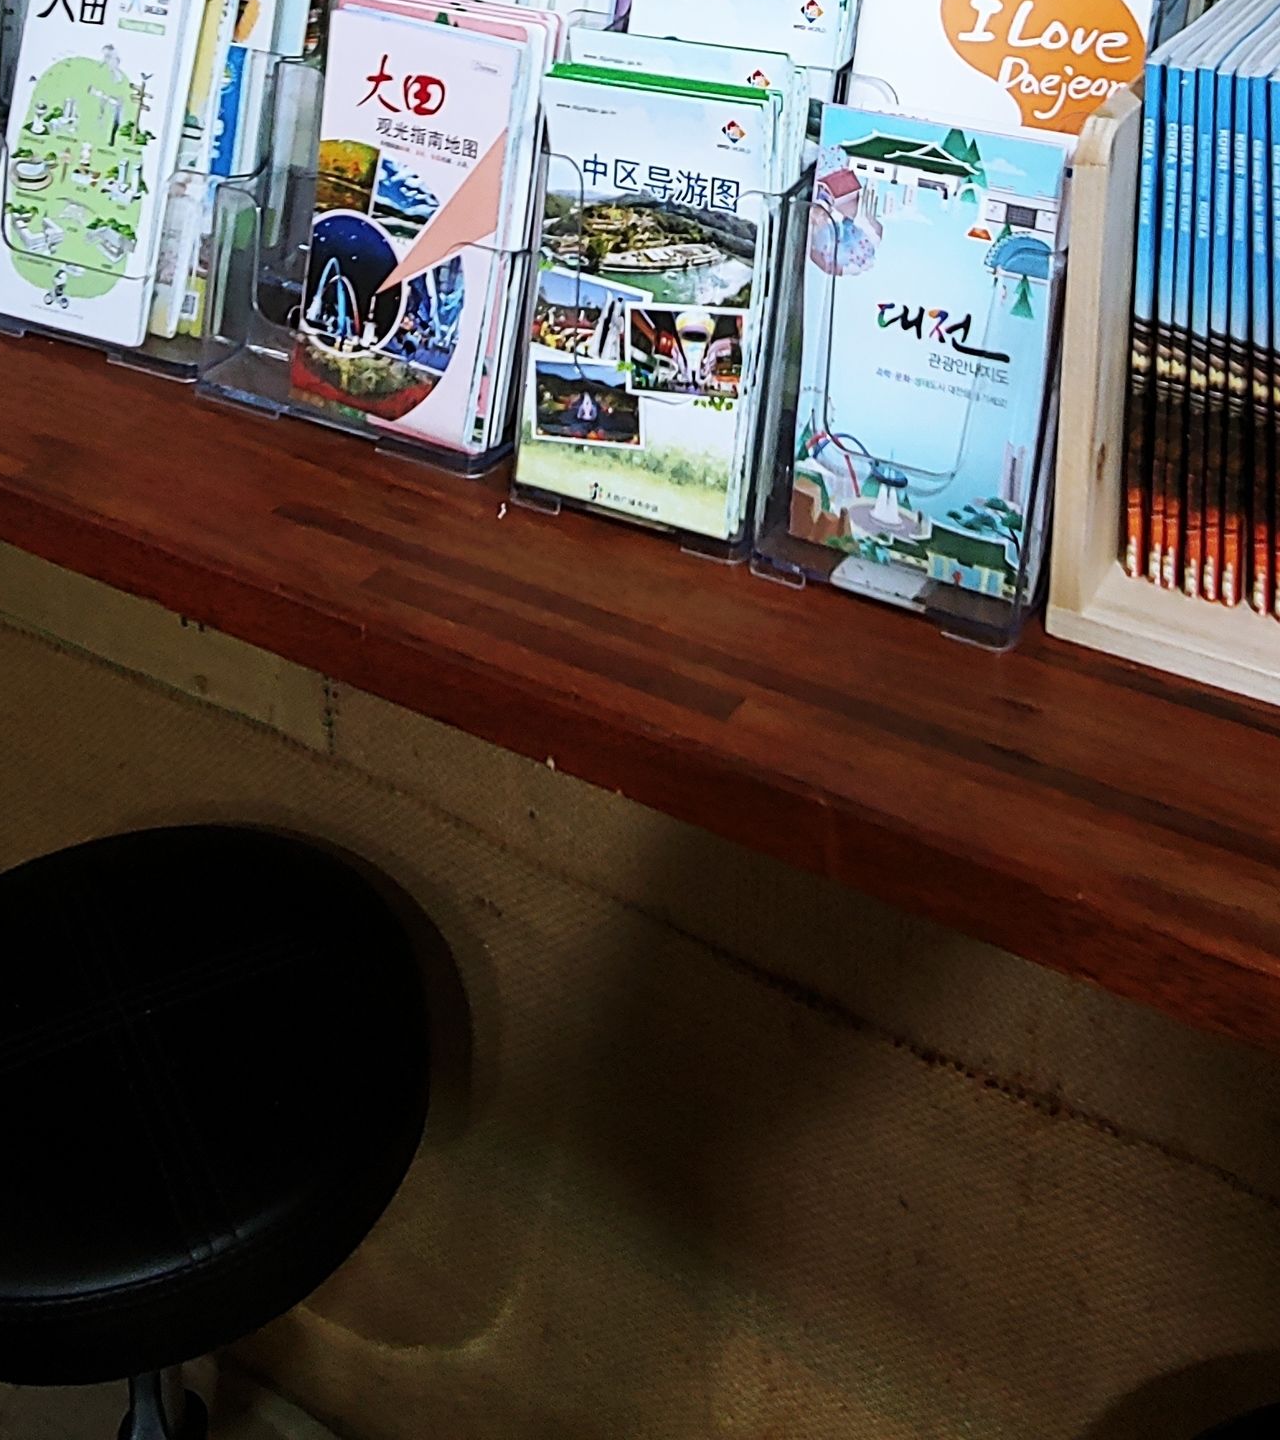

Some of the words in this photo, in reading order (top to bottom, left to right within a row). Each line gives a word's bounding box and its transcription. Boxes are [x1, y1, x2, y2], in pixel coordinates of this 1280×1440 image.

[1007, 0, 1133, 63] Love
[357, 54, 446, 116] 大田
[582, 153, 741, 213] 中区导游图
[877, 302, 1011, 364] 대전
